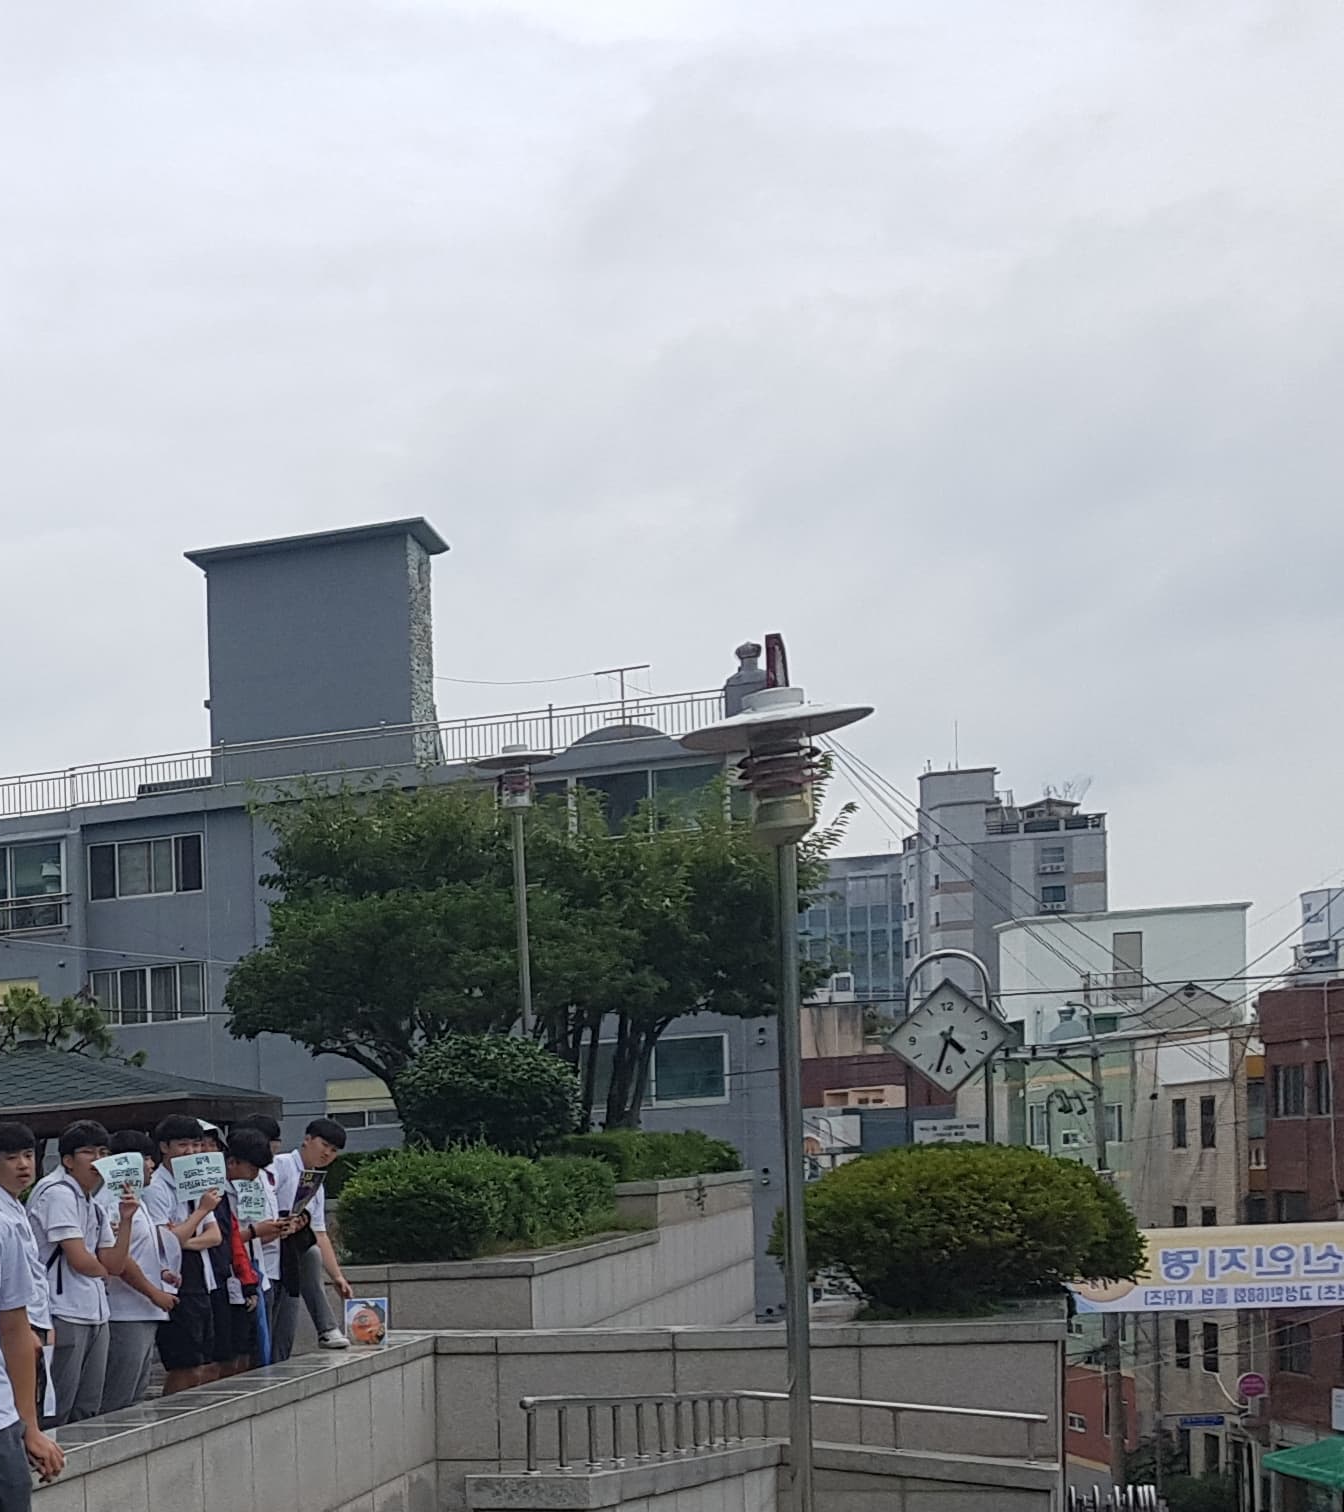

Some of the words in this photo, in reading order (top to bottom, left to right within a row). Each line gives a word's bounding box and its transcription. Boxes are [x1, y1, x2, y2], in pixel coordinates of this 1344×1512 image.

[941, 1001, 955, 1012] 12
[908, 1036, 917, 1046] 9
[980, 1030, 989, 1041] 3
[945, 1064, 953, 1075] 6
